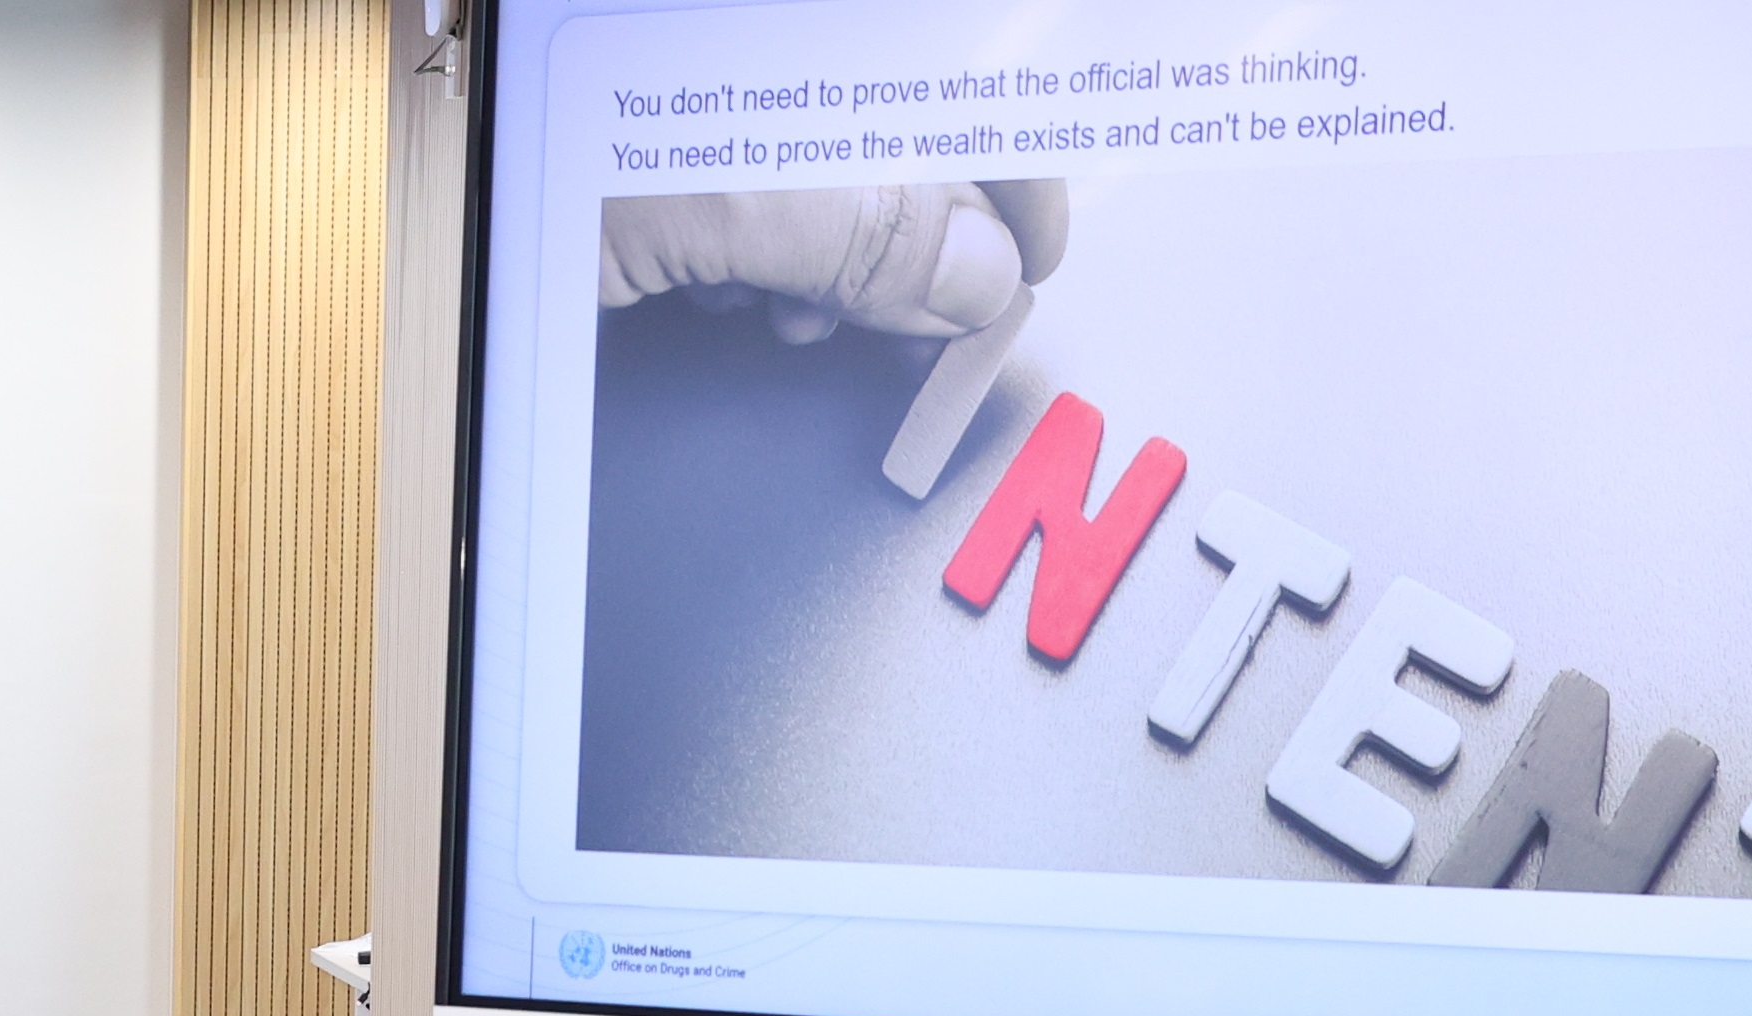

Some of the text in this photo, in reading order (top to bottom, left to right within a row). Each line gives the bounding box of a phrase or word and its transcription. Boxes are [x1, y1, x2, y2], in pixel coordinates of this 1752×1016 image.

[614, 50, 1365, 117] You don't need to prove what the official was thinking.
[612, 101, 1453, 171] You need to prove the wealth exists and can't be explained.
[882, 281, 1752, 895] INTEN
[612, 944, 691, 959] United Nations
[612, 960, 745, 978] Office on Drugs and Crime
